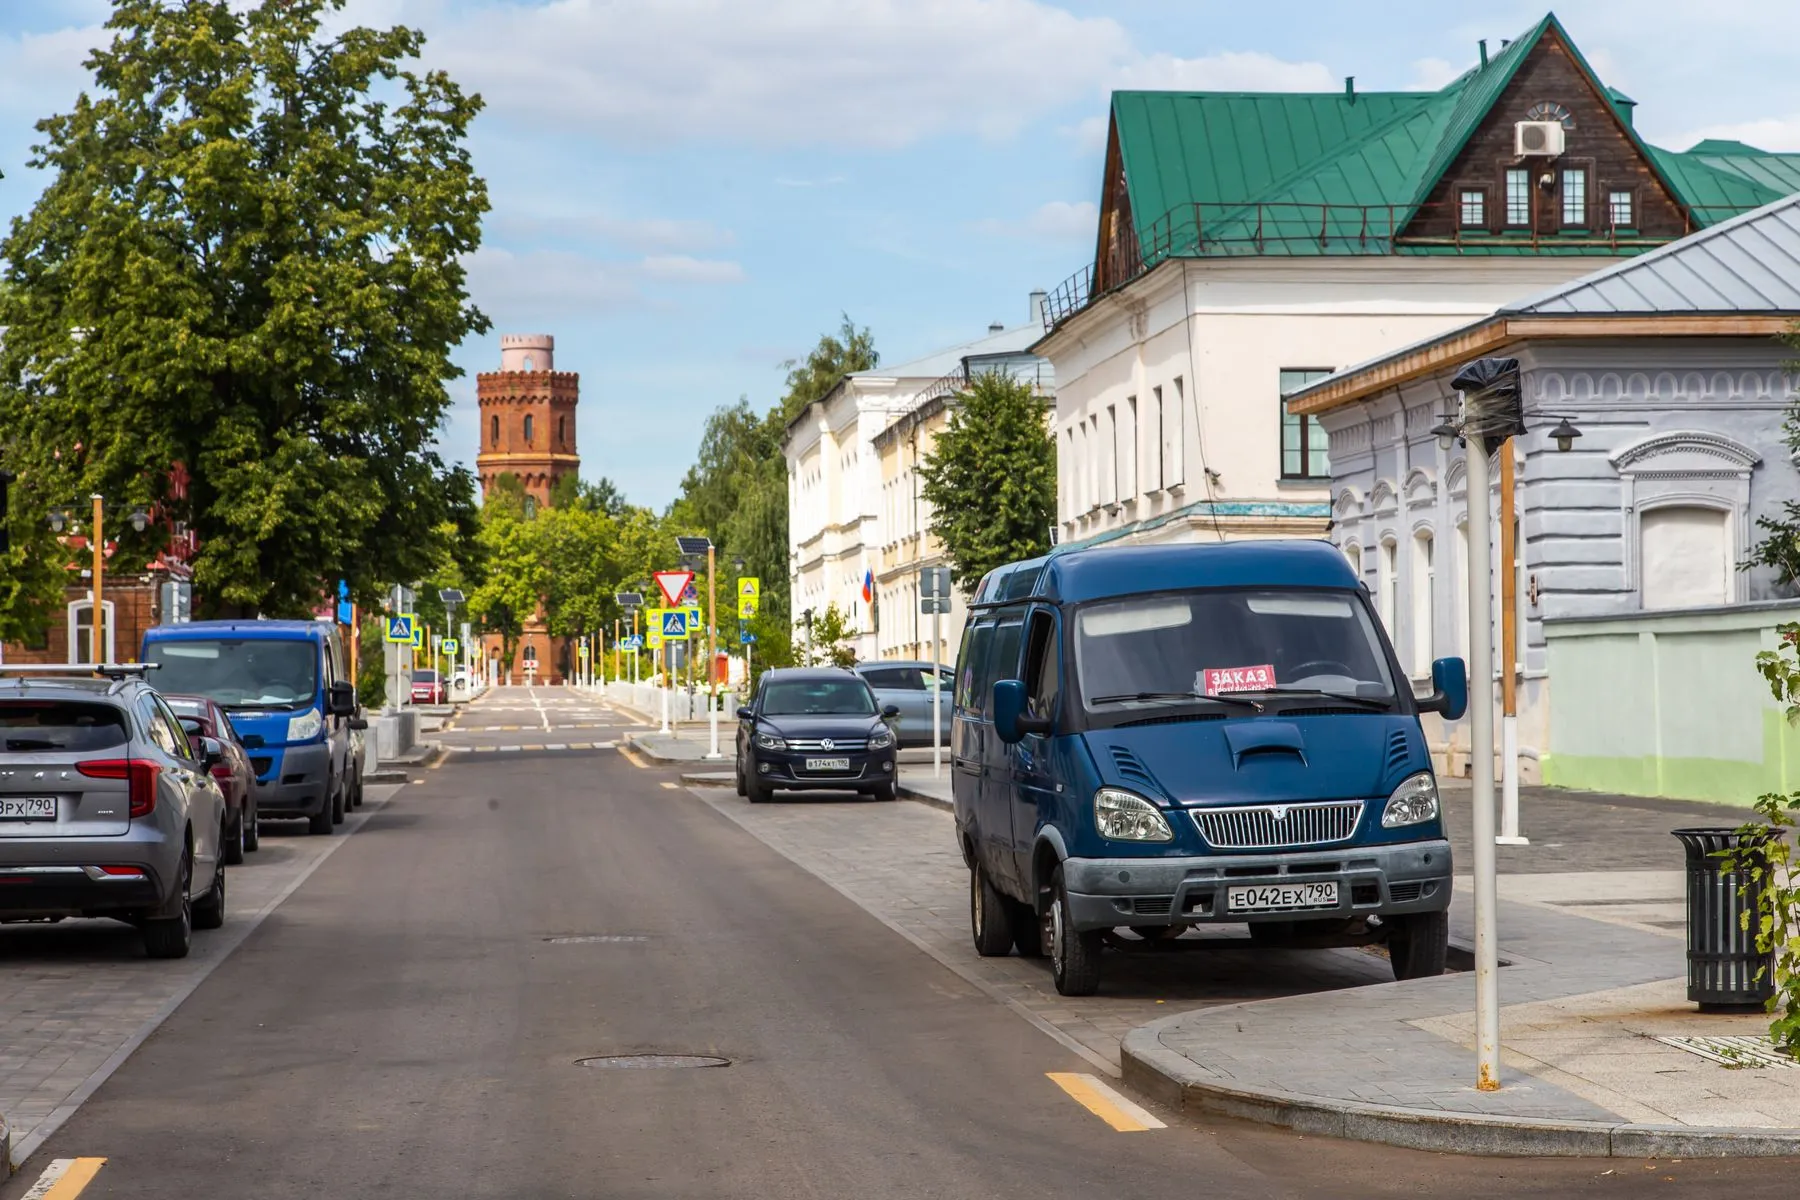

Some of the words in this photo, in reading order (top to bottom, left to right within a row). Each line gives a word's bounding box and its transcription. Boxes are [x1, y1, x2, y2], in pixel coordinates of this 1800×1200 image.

[1211, 669, 1267, 685] ЗАКАЗ
[28, 799, 51, 811] 790
[1235, 888, 1304, 907] Е042ЕХ
[1306, 884, 1333, 898] 790
